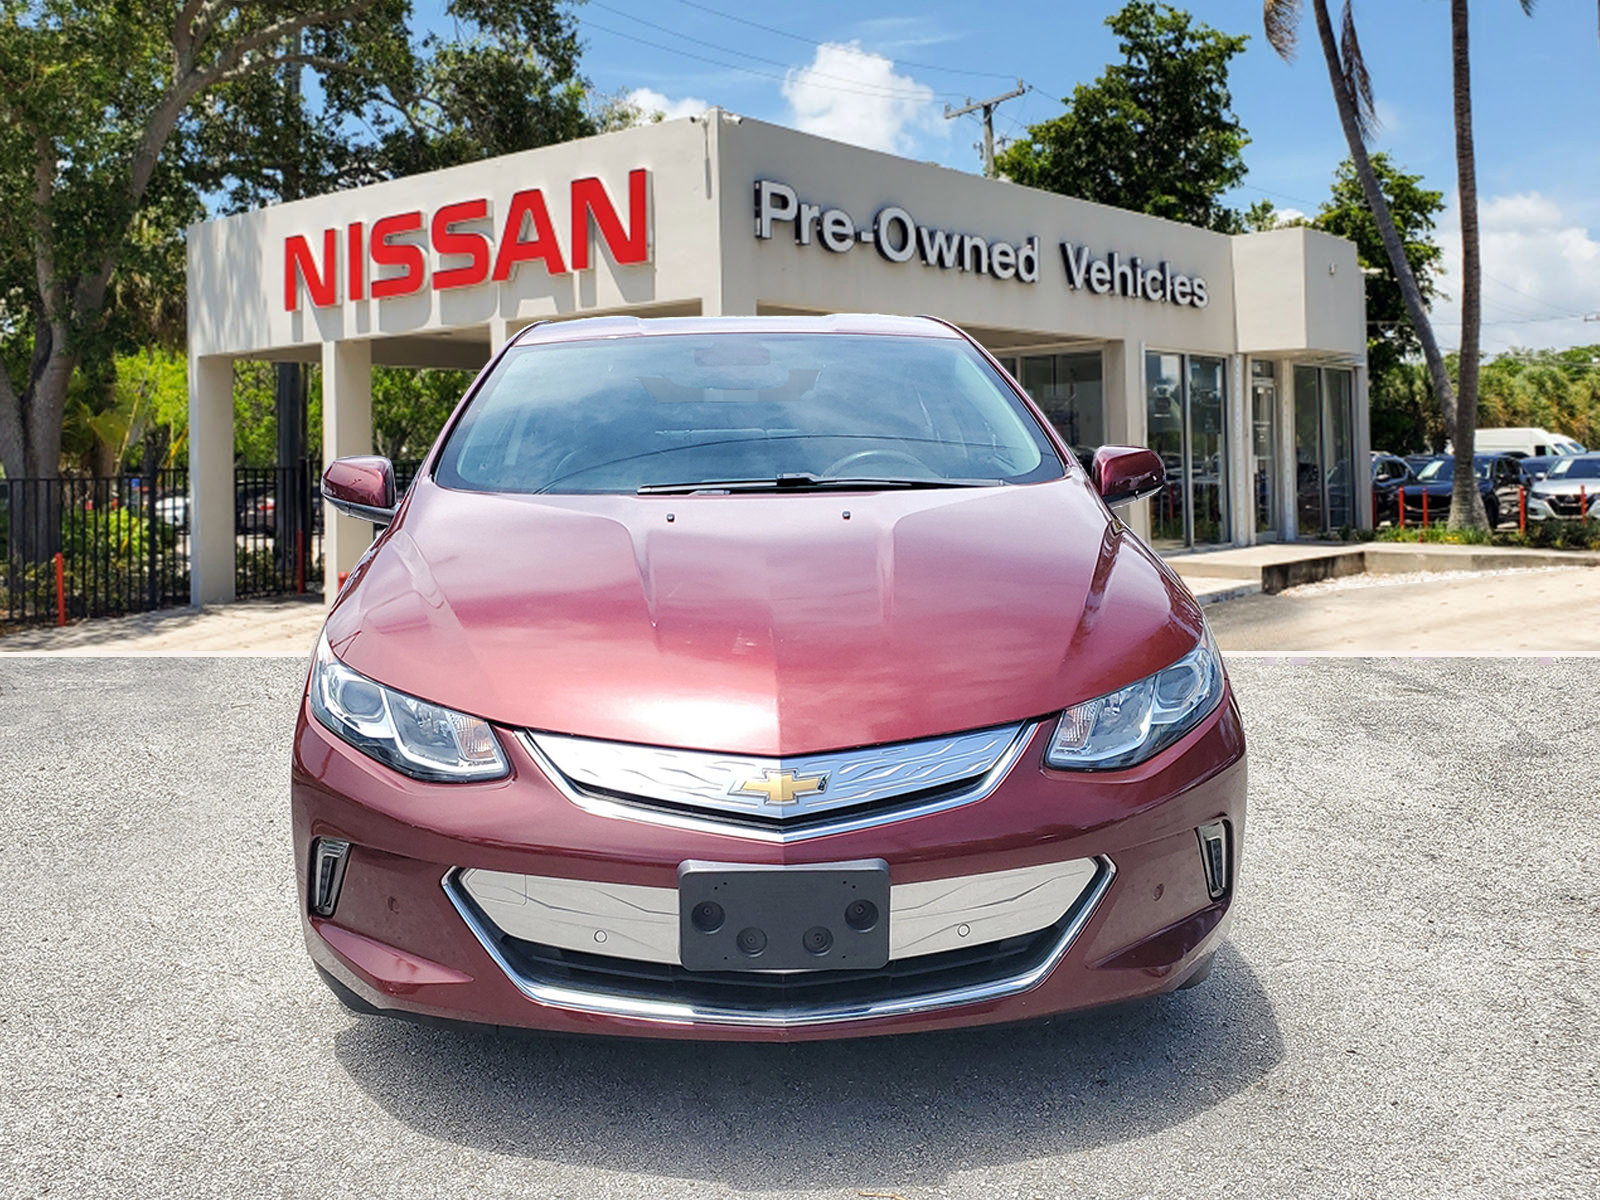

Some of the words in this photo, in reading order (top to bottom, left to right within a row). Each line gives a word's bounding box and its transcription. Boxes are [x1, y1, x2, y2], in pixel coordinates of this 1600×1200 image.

[284, 169, 652, 312] NISSAN
[754, 180, 1041, 283] Pre-Owned
[1059, 241, 1209, 308] Vehicles
